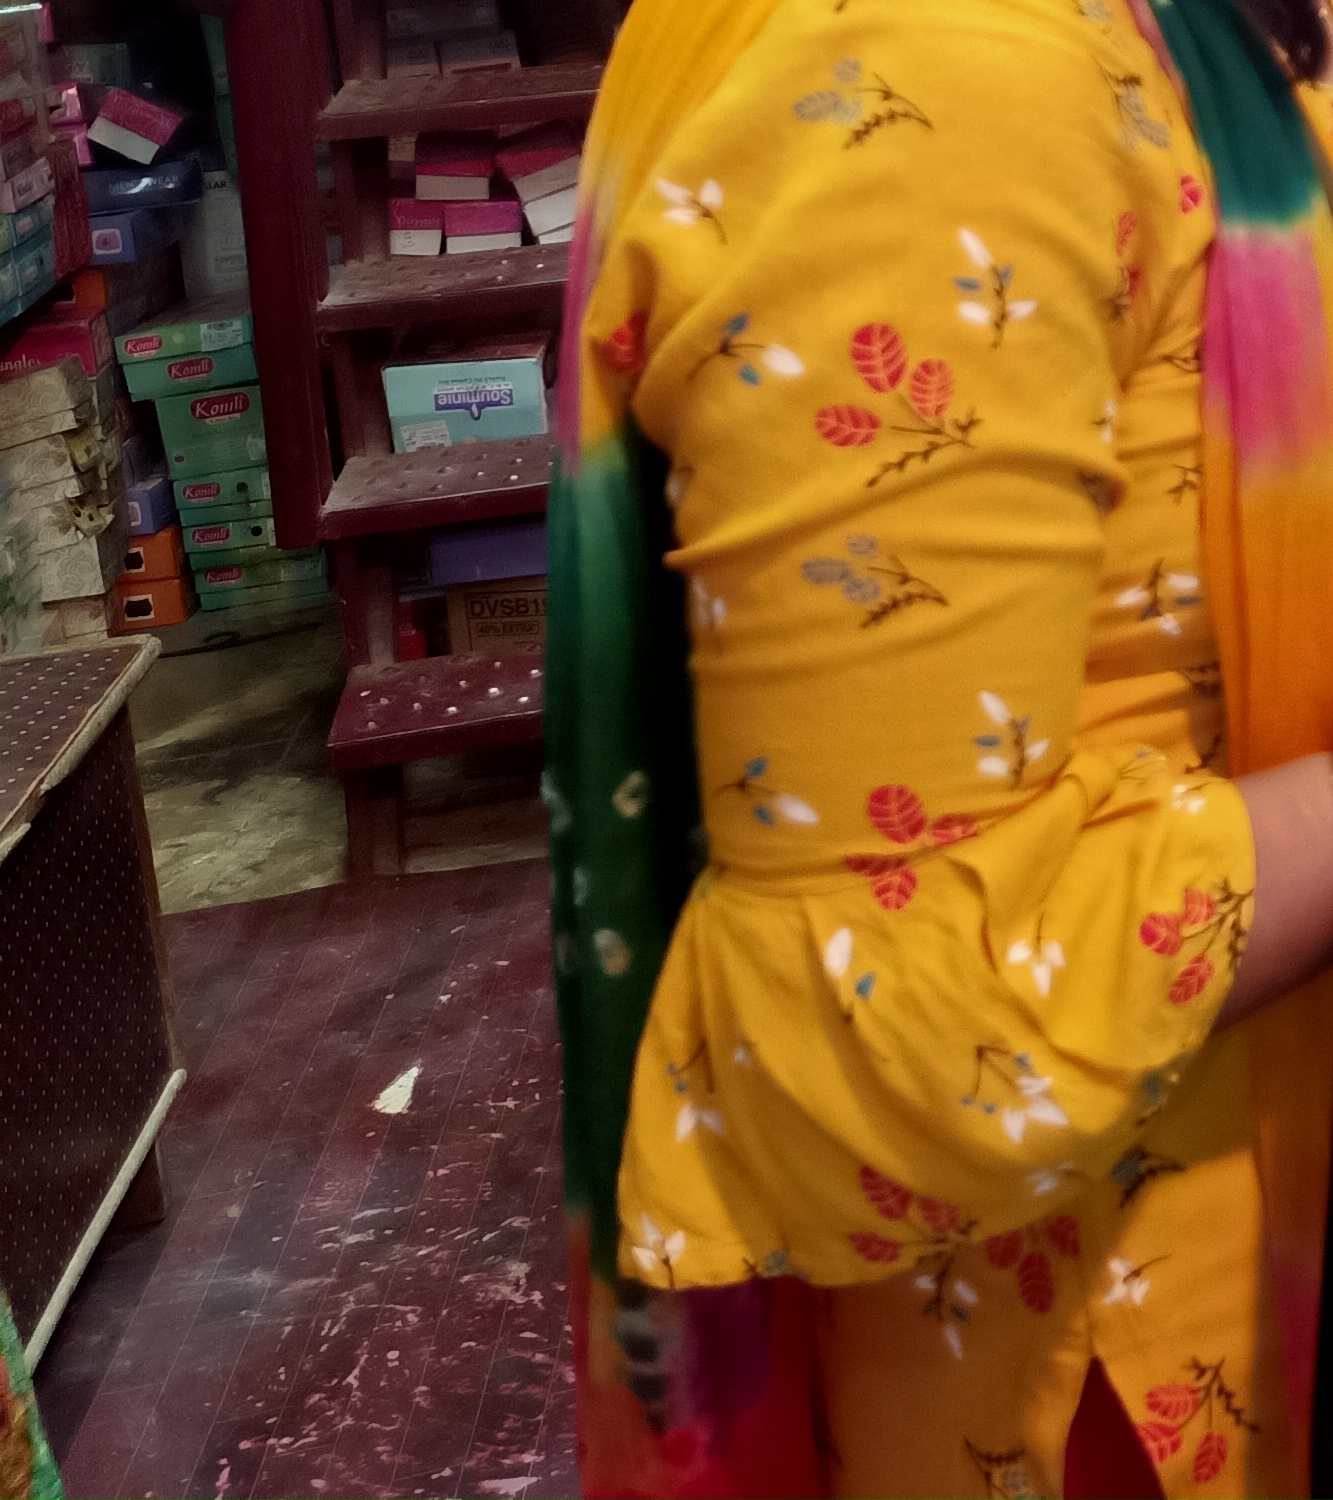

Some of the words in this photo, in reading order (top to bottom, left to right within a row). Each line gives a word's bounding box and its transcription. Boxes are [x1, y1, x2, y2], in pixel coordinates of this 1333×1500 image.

[126, 338, 161, 353] Komli
[171, 360, 210, 377] Komli
[438, 388, 512, 406] Souminie
[195, 396, 244, 418] Komli
[185, 485, 218, 498] Komli
[194, 528, 227, 542] Komli
[206, 568, 239, 582] Komli
